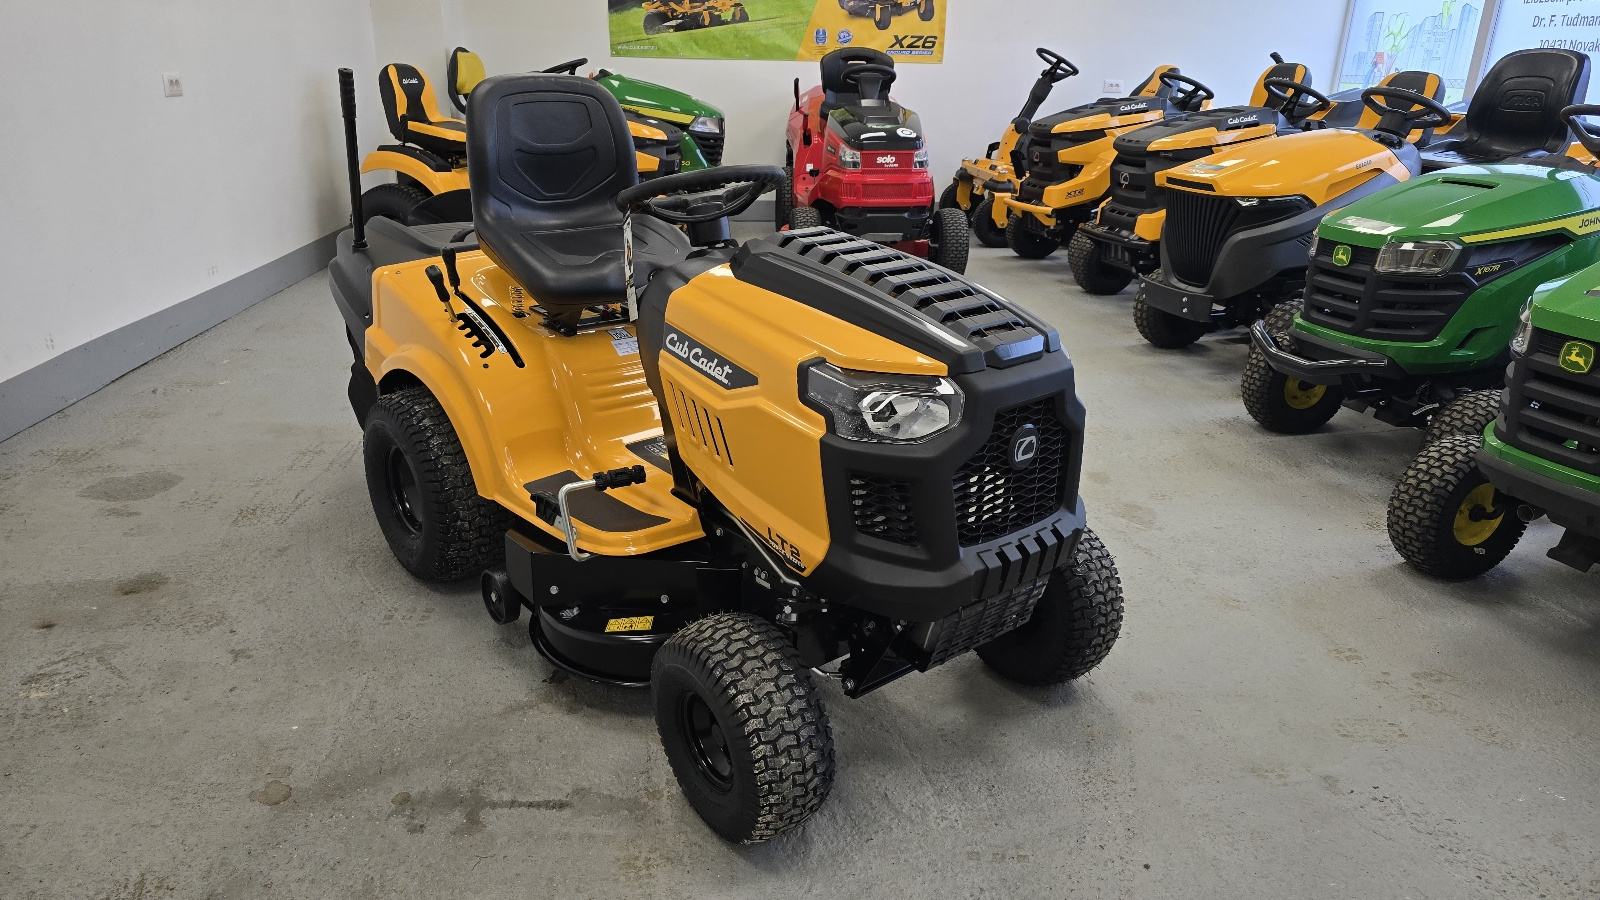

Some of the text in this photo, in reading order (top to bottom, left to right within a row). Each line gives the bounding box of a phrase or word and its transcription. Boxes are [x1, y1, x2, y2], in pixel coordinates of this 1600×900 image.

[1532, 15, 1546, 28] Dr.
[1548, 15, 1557, 27] F.
[889, 35, 938, 49] XZ6
[1240, 114, 1258, 122] Cadet
[876, 155, 895, 164] solo
[666, 333, 689, 359] Cub
[689, 348, 733, 385] Cadet
[768, 526, 802, 562] LT2
